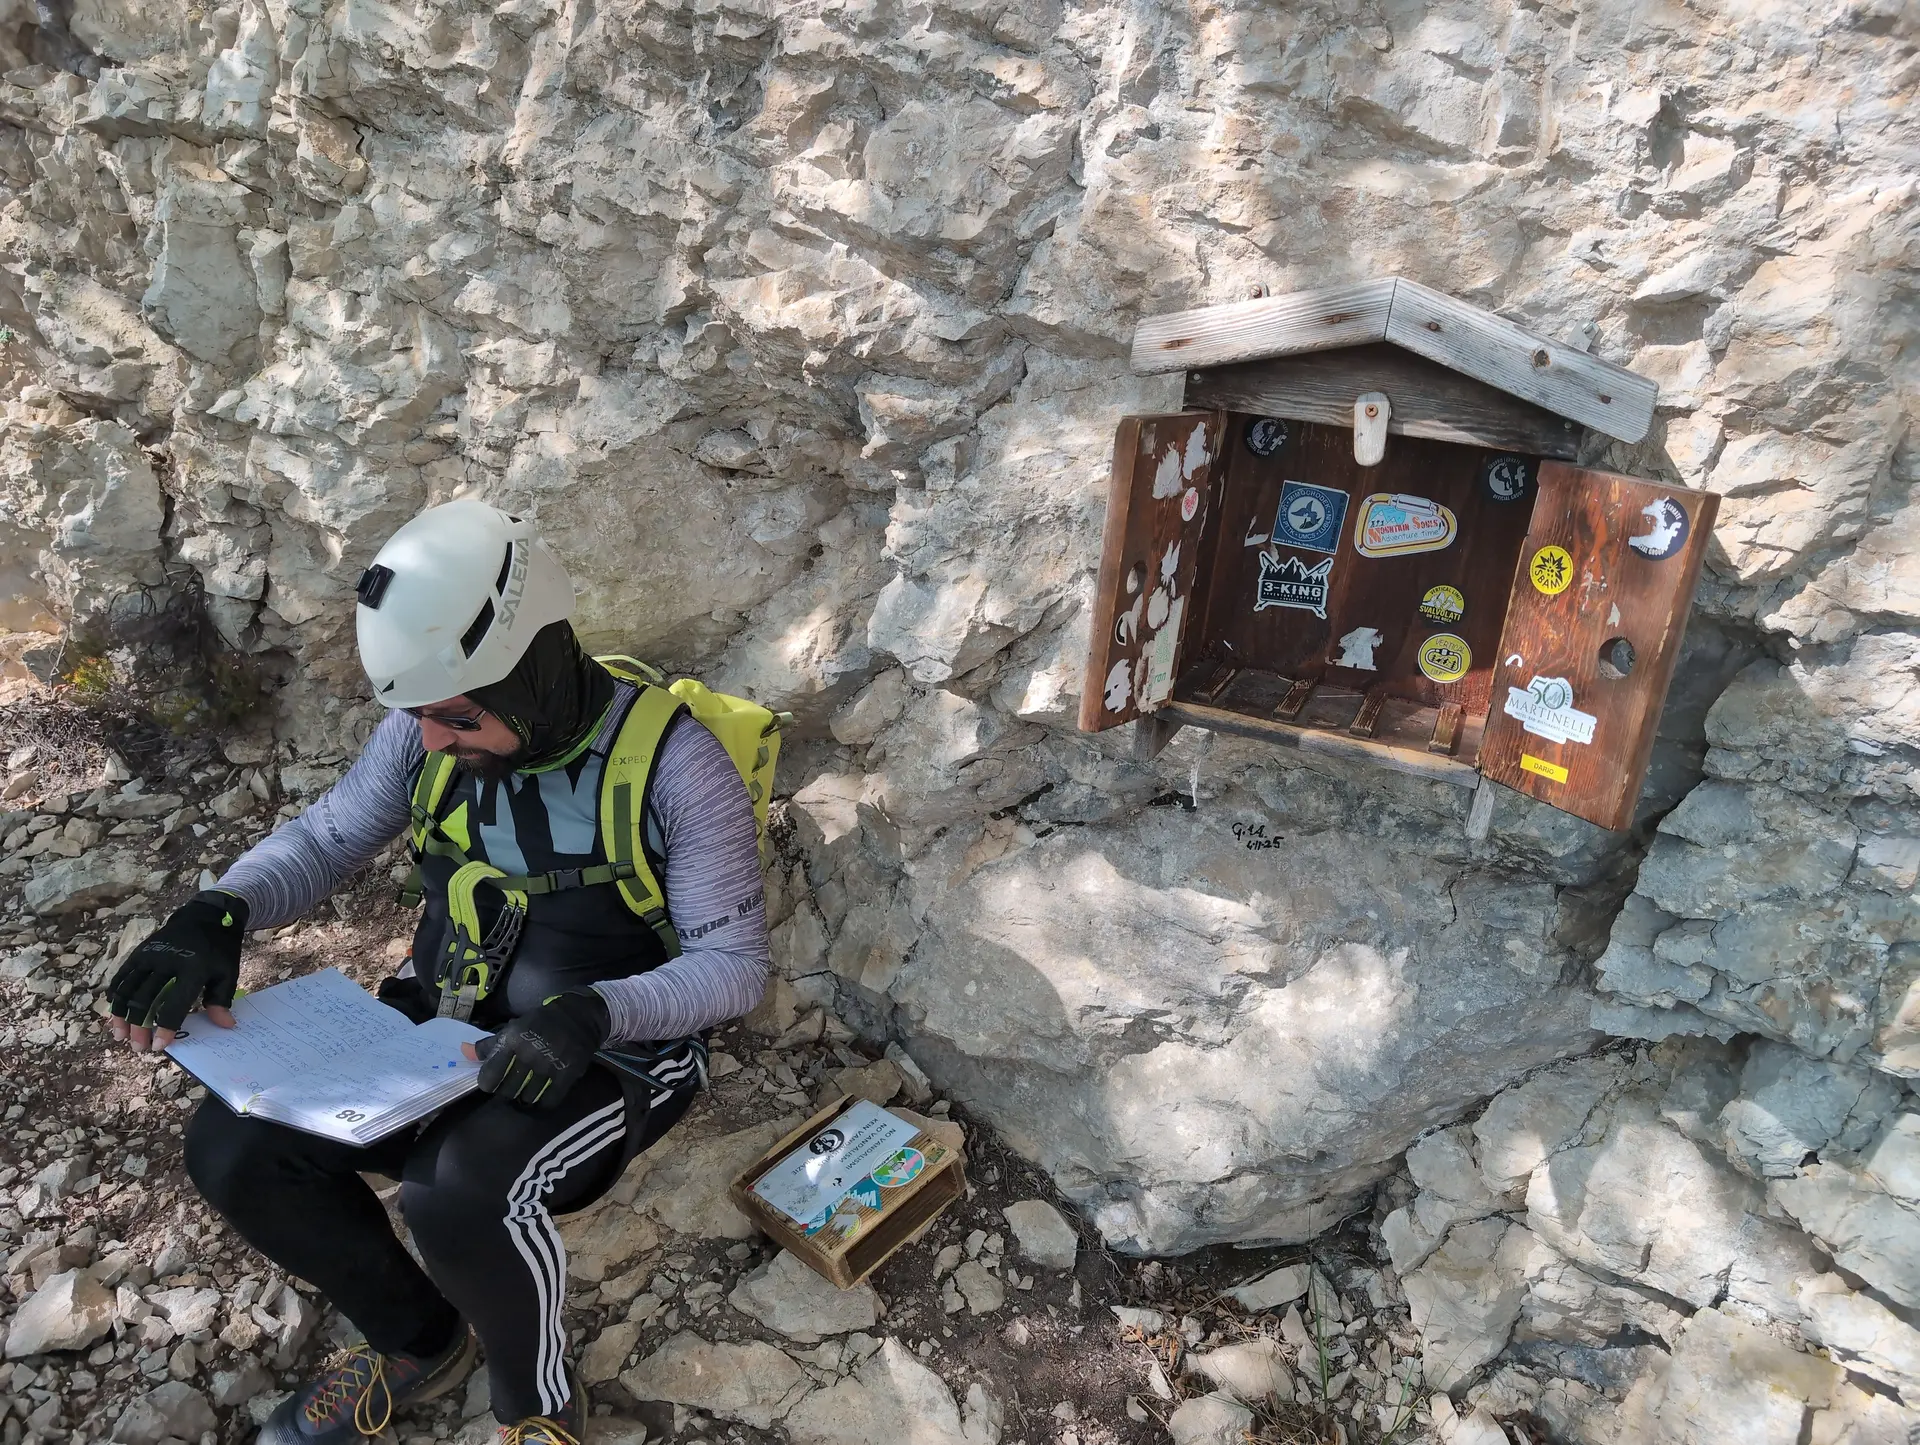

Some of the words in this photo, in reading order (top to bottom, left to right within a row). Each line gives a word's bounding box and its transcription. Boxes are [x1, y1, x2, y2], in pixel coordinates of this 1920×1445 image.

[1288, 489, 1331, 508] MIMOCHODEK
[1283, 520, 1294, 536] PTTK
[1319, 514, 1332, 535] LUBLIN
[498, 538, 529, 631] SALEWA
[1535, 569, 1561, 589] SBAM
[1263, 582, 1322, 598] 3-KING
[1430, 586, 1452, 595] VERTICAL
[1419, 605, 1461, 621] SVALVOLATI
[1435, 637, 1465, 654] VERTICAL
[1530, 679, 1566, 710] 50
[1508, 696, 1592, 736] MARTINELLI
[612, 755, 648, 766] EXPED
[1533, 762, 1555, 775] DARIO
[323, 792, 346, 844] arina
[680, 915, 730, 940] Aqua
[520, 1031, 566, 1070] CHIBA
[335, 1109, 366, 1123] 08
[863, 1118, 878, 1131] KEIN
[876, 1122, 887, 1133] NO
[885, 1128, 896, 1138] NO
[839, 1132, 878, 1163] VANDALISM
[845, 1138, 886, 1170] VANDALISMI
